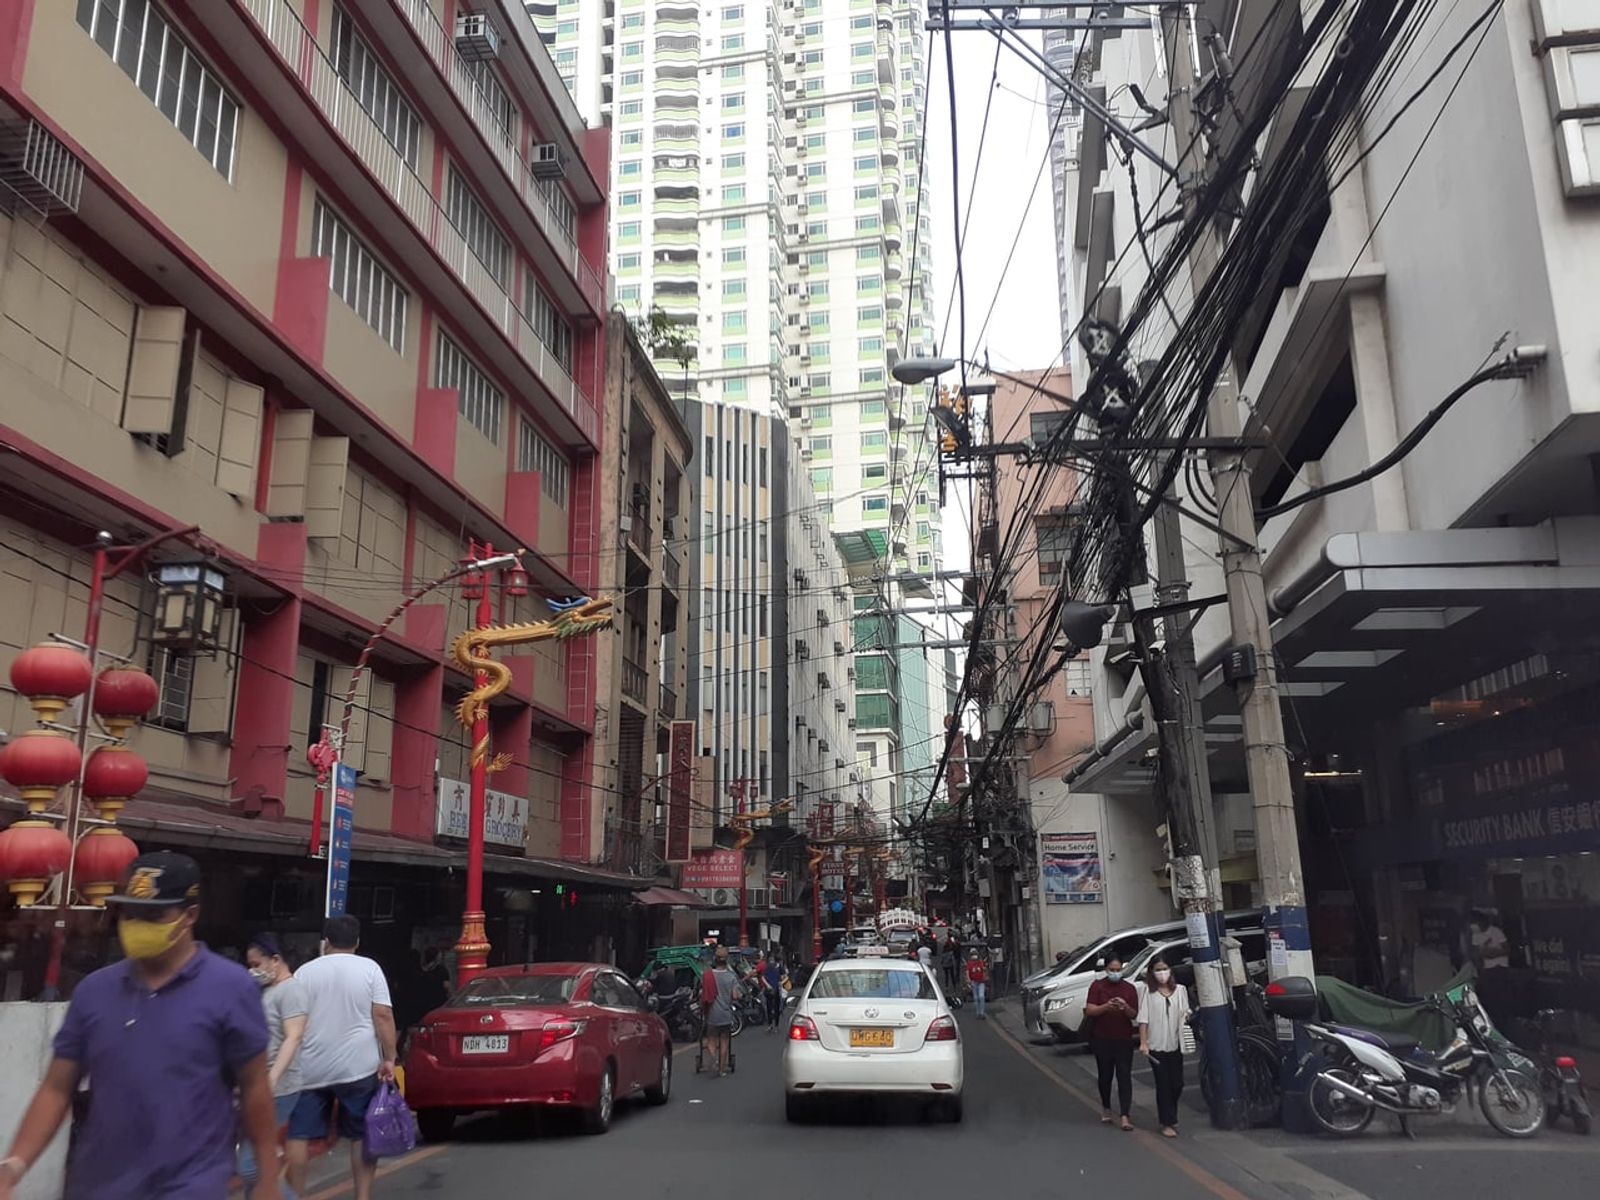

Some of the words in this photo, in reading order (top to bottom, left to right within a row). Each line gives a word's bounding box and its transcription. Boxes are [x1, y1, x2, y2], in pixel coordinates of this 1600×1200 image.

[486, 818, 521, 840] GROCERY
[1444, 815, 1500, 847] SECURITY
[1502, 808, 1546, 840] BANK
[1045, 843, 1067, 851] Home
[1068, 842, 1094, 851] Service
[710, 864, 738, 872] SELECT
[464, 1038, 480, 1050] NDH
